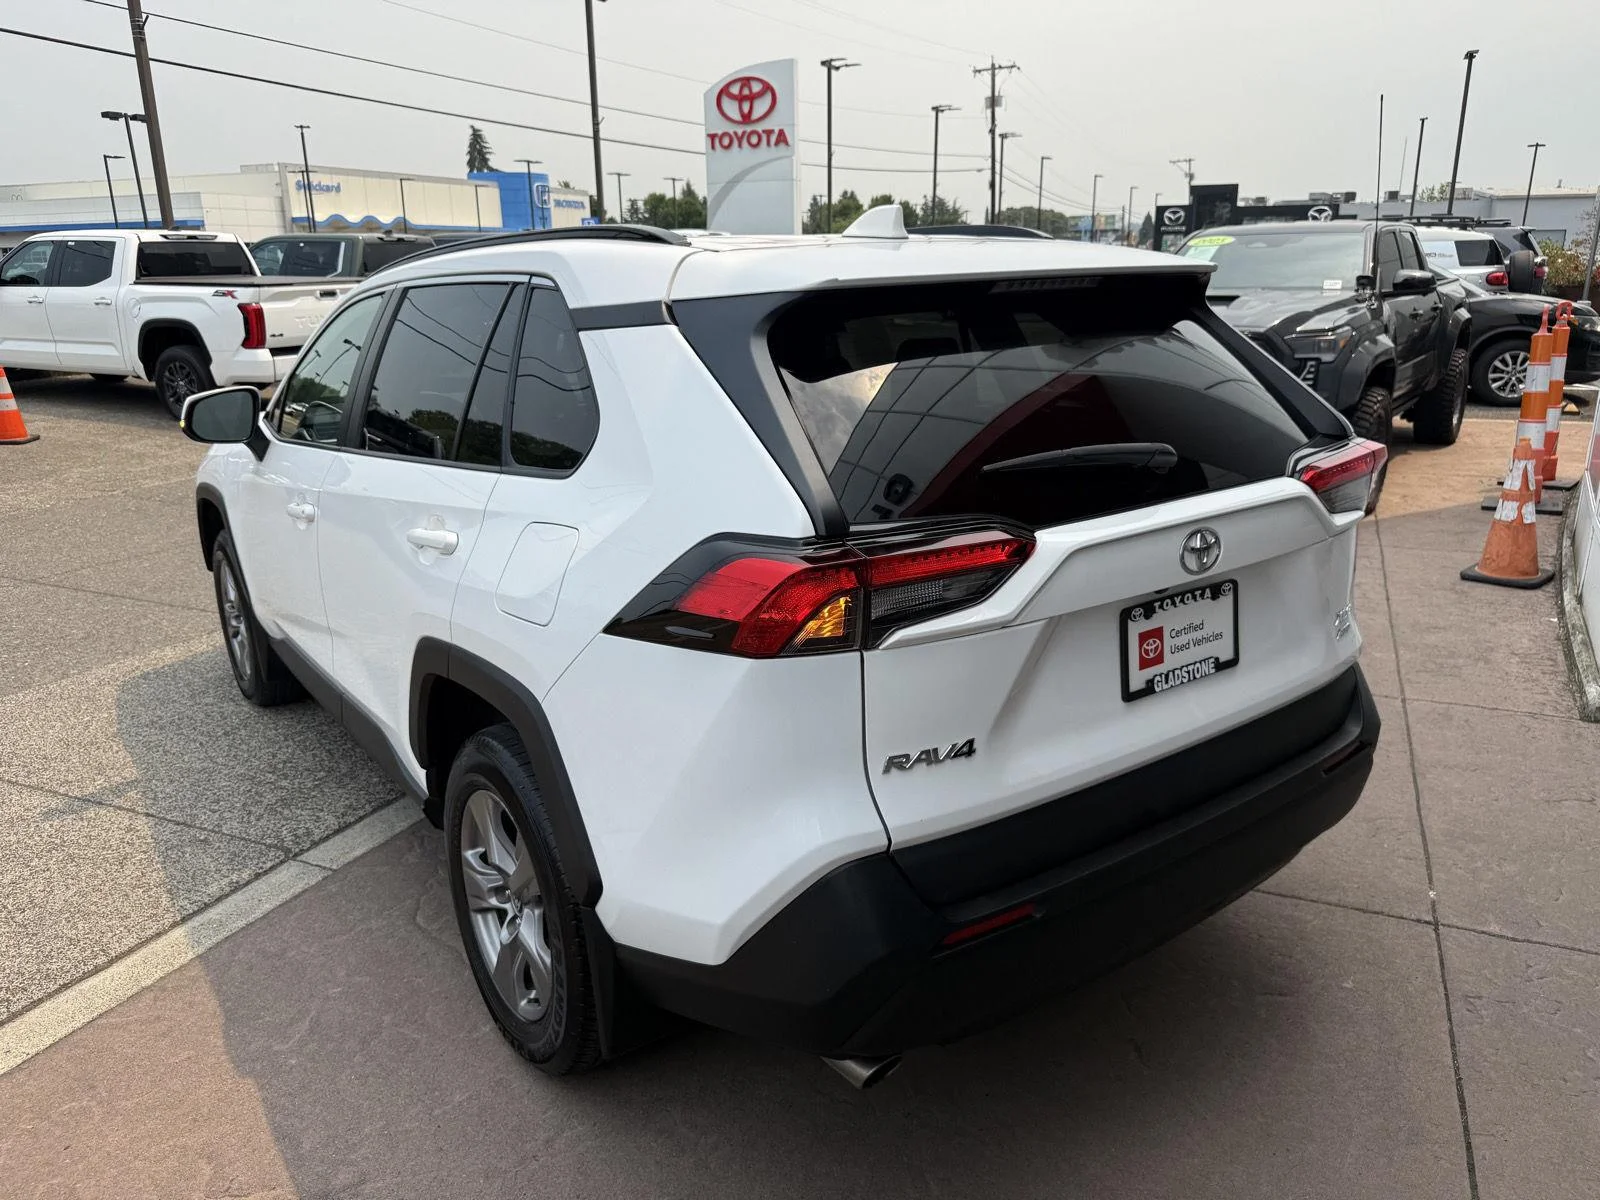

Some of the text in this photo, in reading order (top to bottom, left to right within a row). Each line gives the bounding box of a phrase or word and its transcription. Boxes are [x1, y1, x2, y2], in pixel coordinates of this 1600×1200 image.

[707, 128, 790, 151] TOYOTA
[1154, 587, 1212, 613] TOYOTA
[1169, 620, 1204, 639] Certified
[1170, 631, 1223, 655] Used Vehicles
[1153, 657, 1216, 692] GLADSTONE
[881, 737, 977, 775] RAV4
